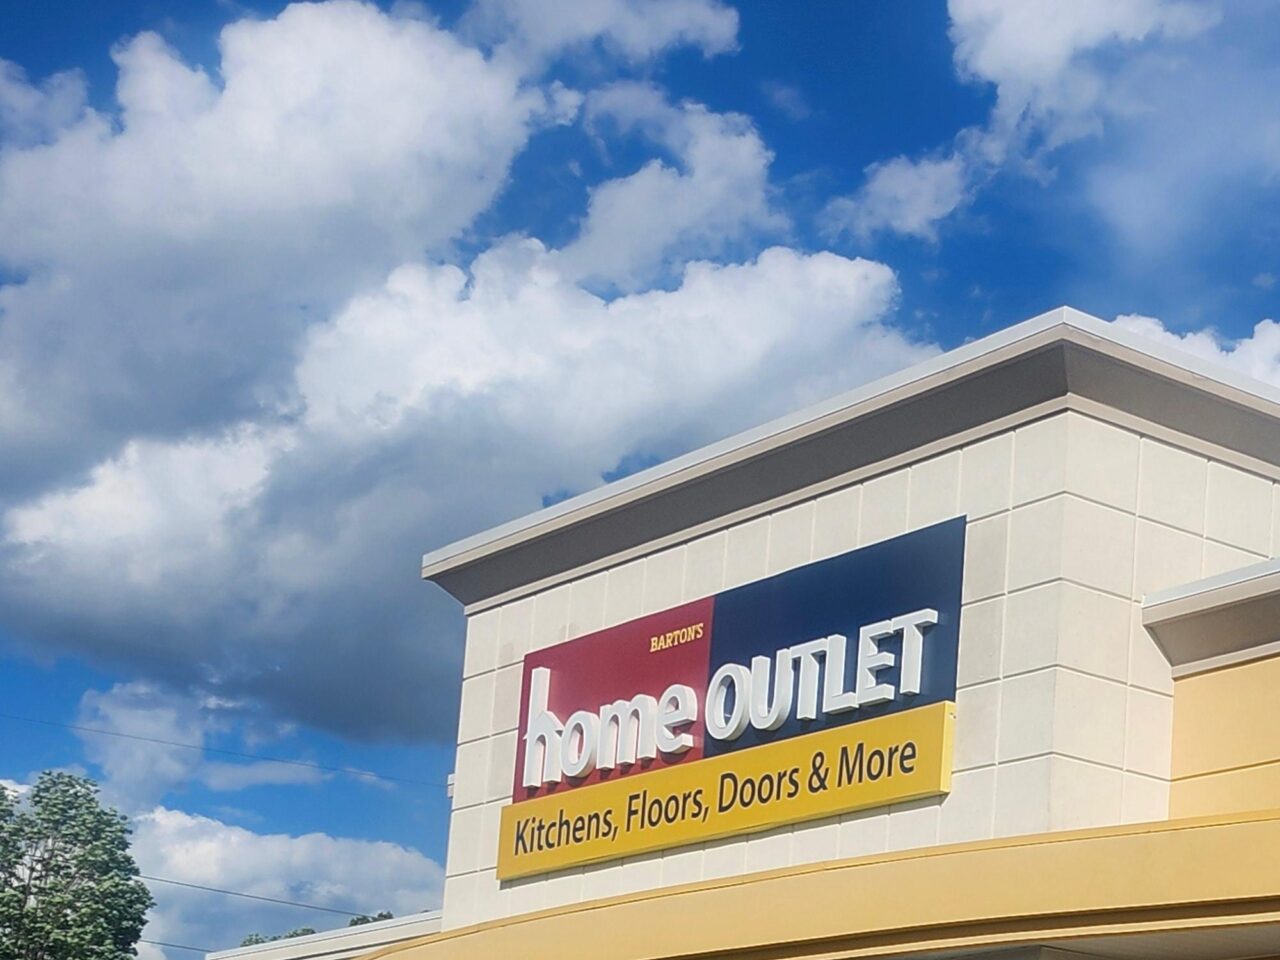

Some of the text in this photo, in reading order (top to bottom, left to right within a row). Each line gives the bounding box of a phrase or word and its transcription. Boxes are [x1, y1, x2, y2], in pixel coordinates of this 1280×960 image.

[650, 622, 704, 652] BARTON'S
[522, 608, 938, 788] home OUTLET
[514, 742, 917, 856] Kitchens, Floors, Doors & More
